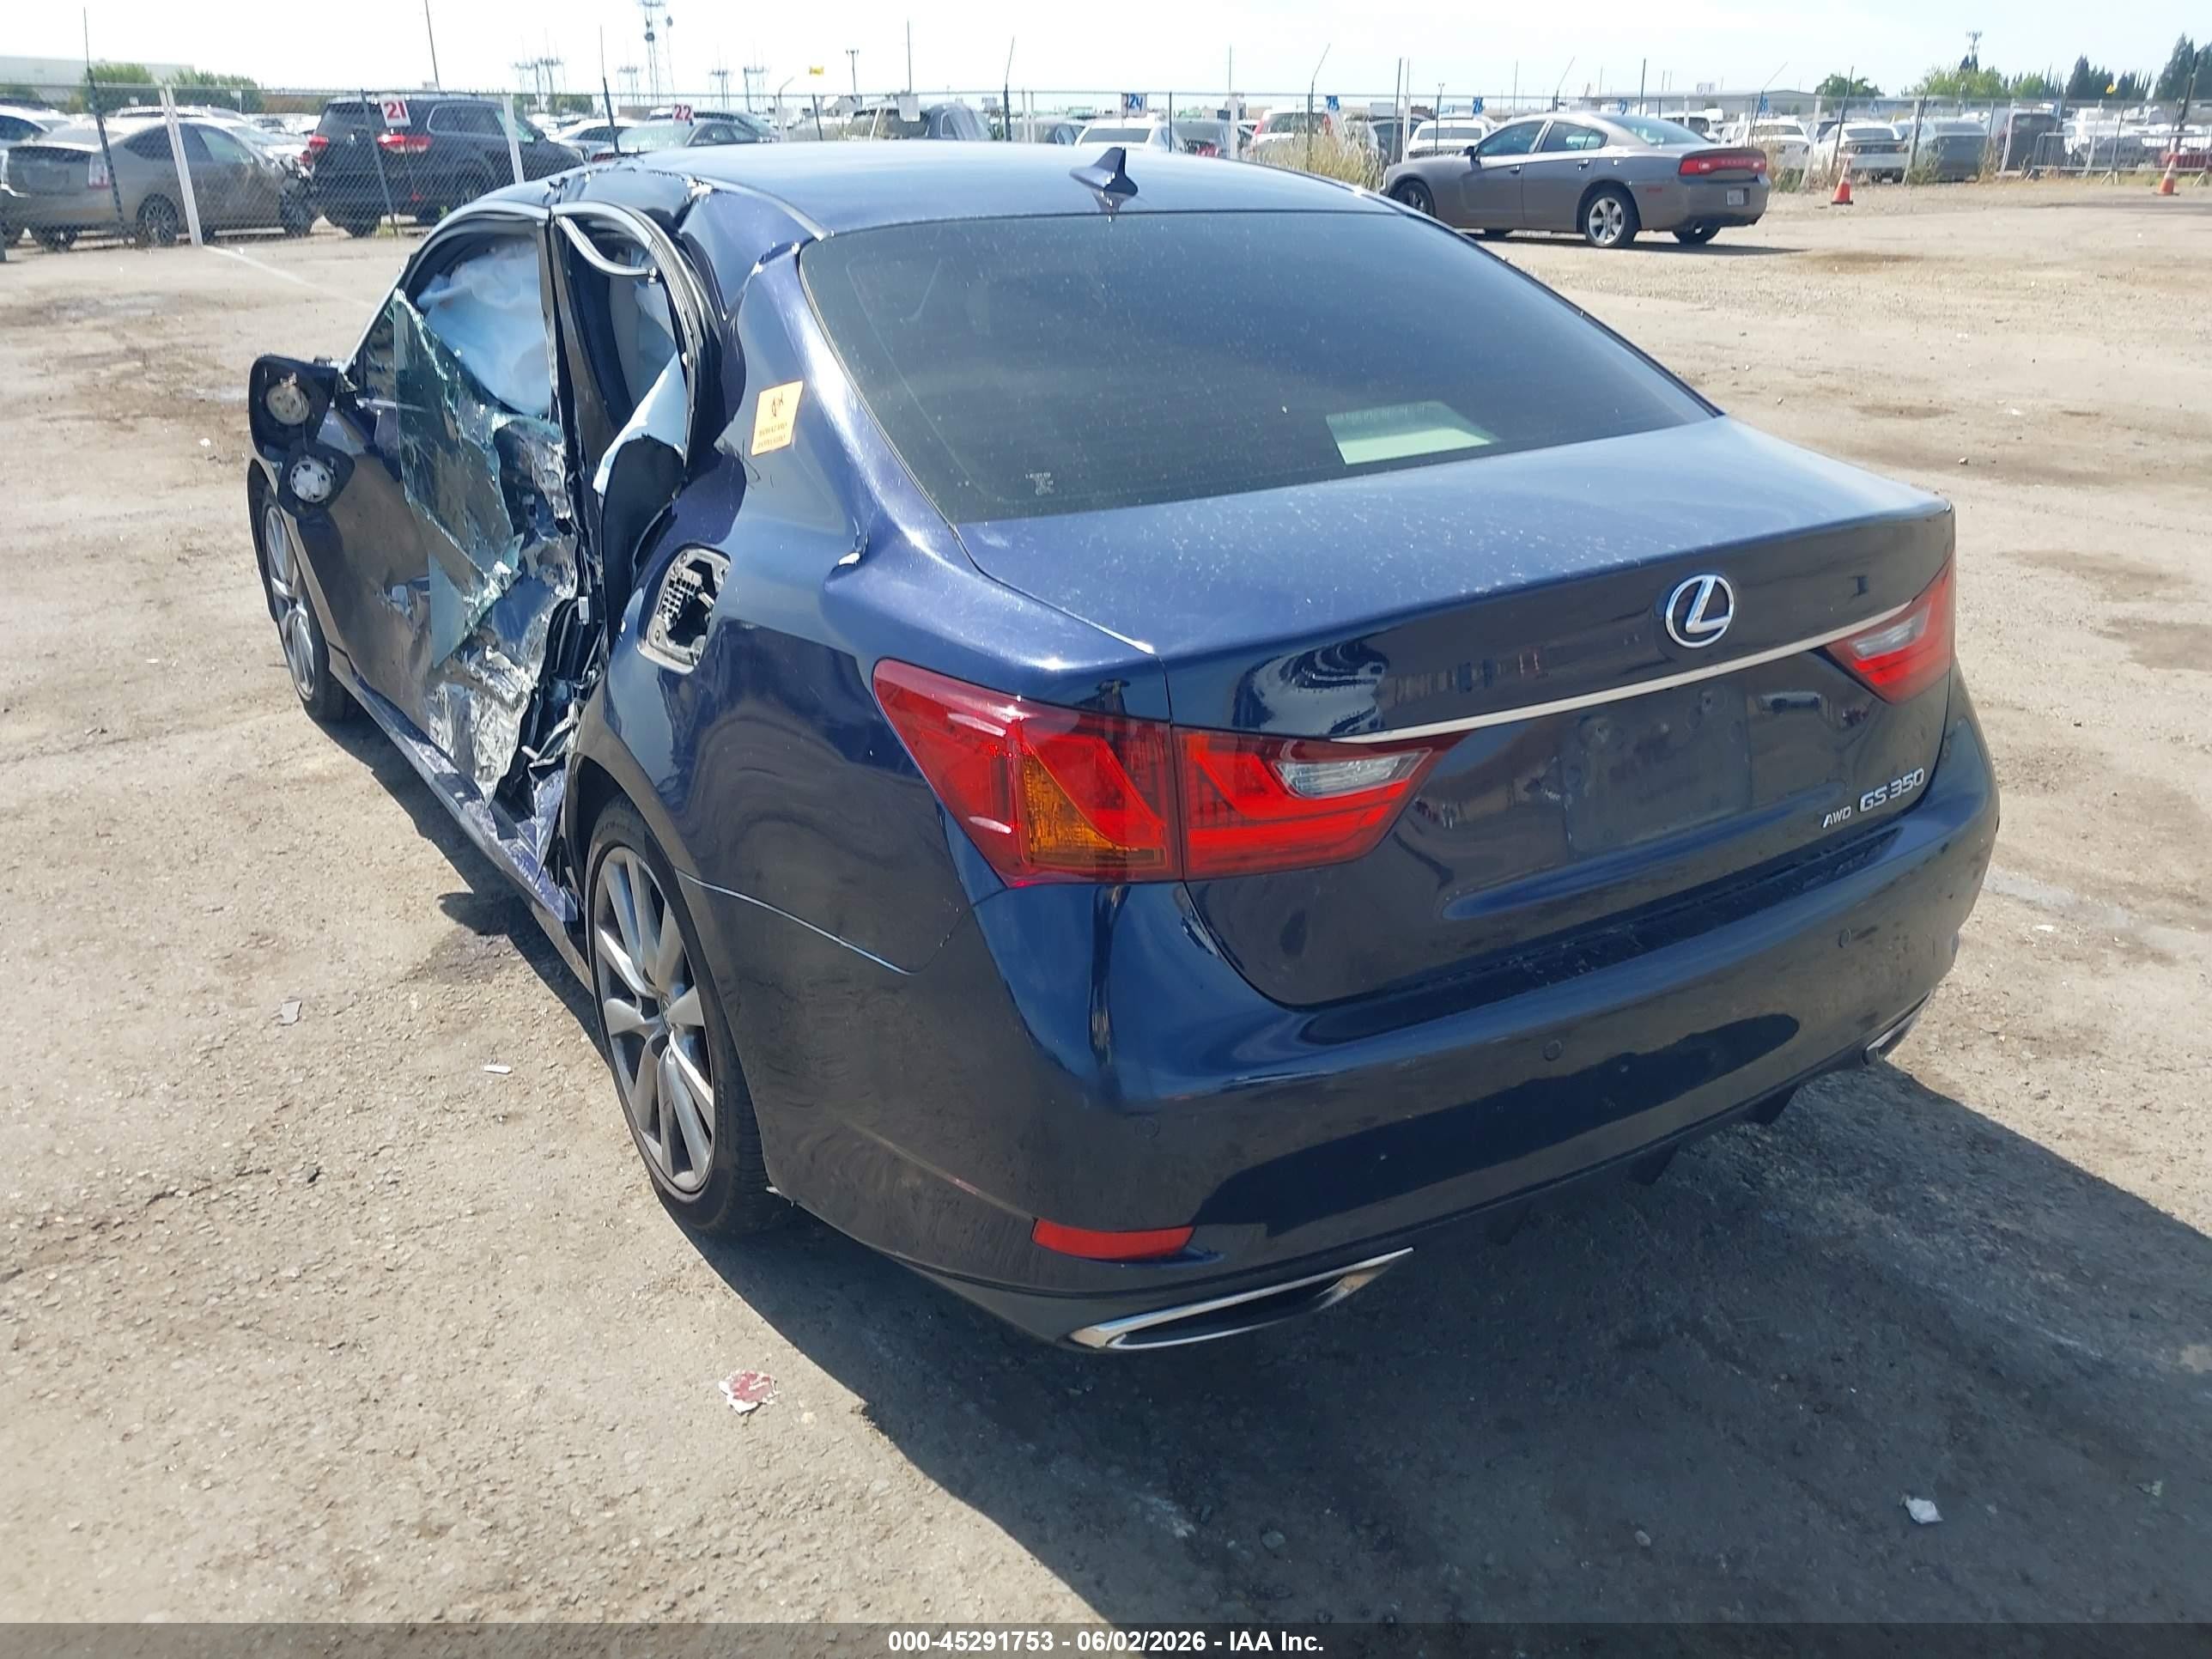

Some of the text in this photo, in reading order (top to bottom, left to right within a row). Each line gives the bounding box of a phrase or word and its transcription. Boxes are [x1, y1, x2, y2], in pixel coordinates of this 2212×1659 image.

[384, 100, 406, 119] 21
[1127, 94, 1143, 112] 24
[674, 105, 691, 121] 22
[1822, 767, 1924, 828] AWD GS 350
